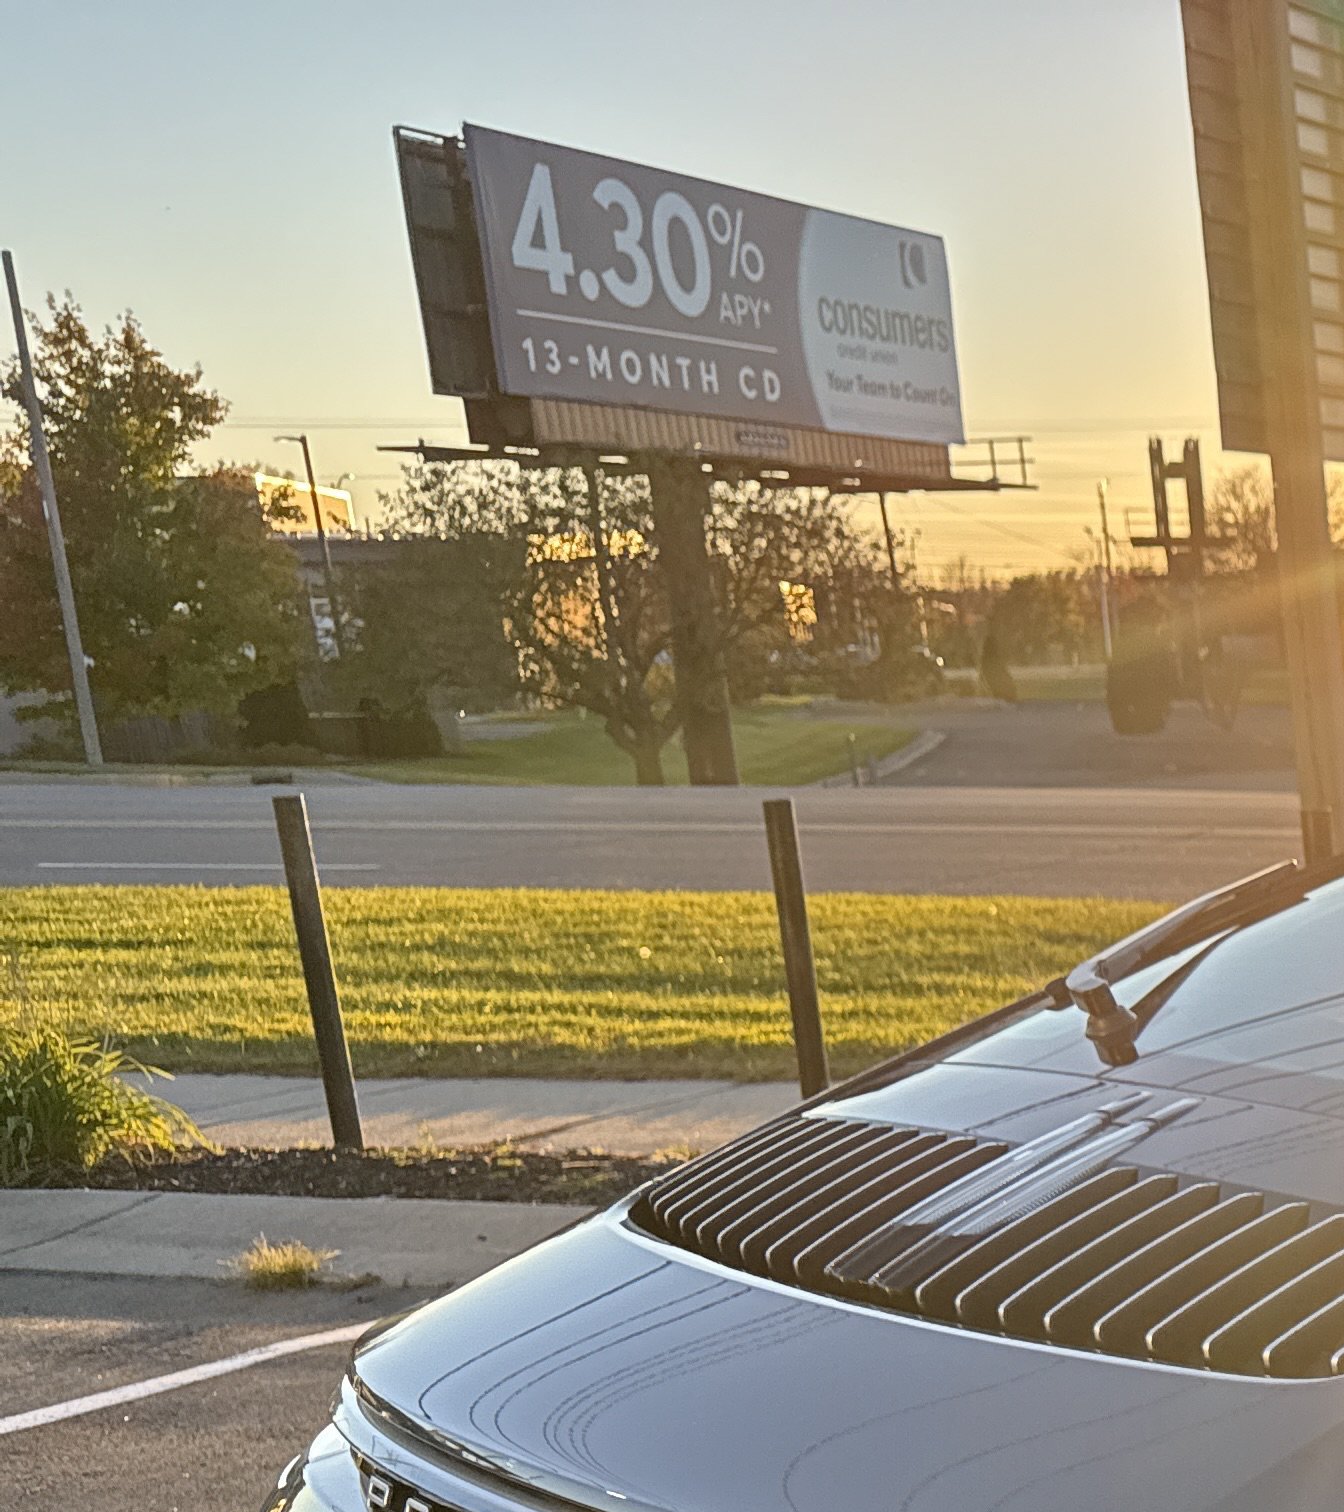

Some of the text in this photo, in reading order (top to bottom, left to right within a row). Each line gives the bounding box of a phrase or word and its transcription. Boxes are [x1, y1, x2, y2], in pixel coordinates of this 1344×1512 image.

[817, 295, 950, 354] consumers
[521, 336, 781, 402] 13-MONTH CD
[826, 369, 853, 393] Your
[855, 373, 889, 397] Team
